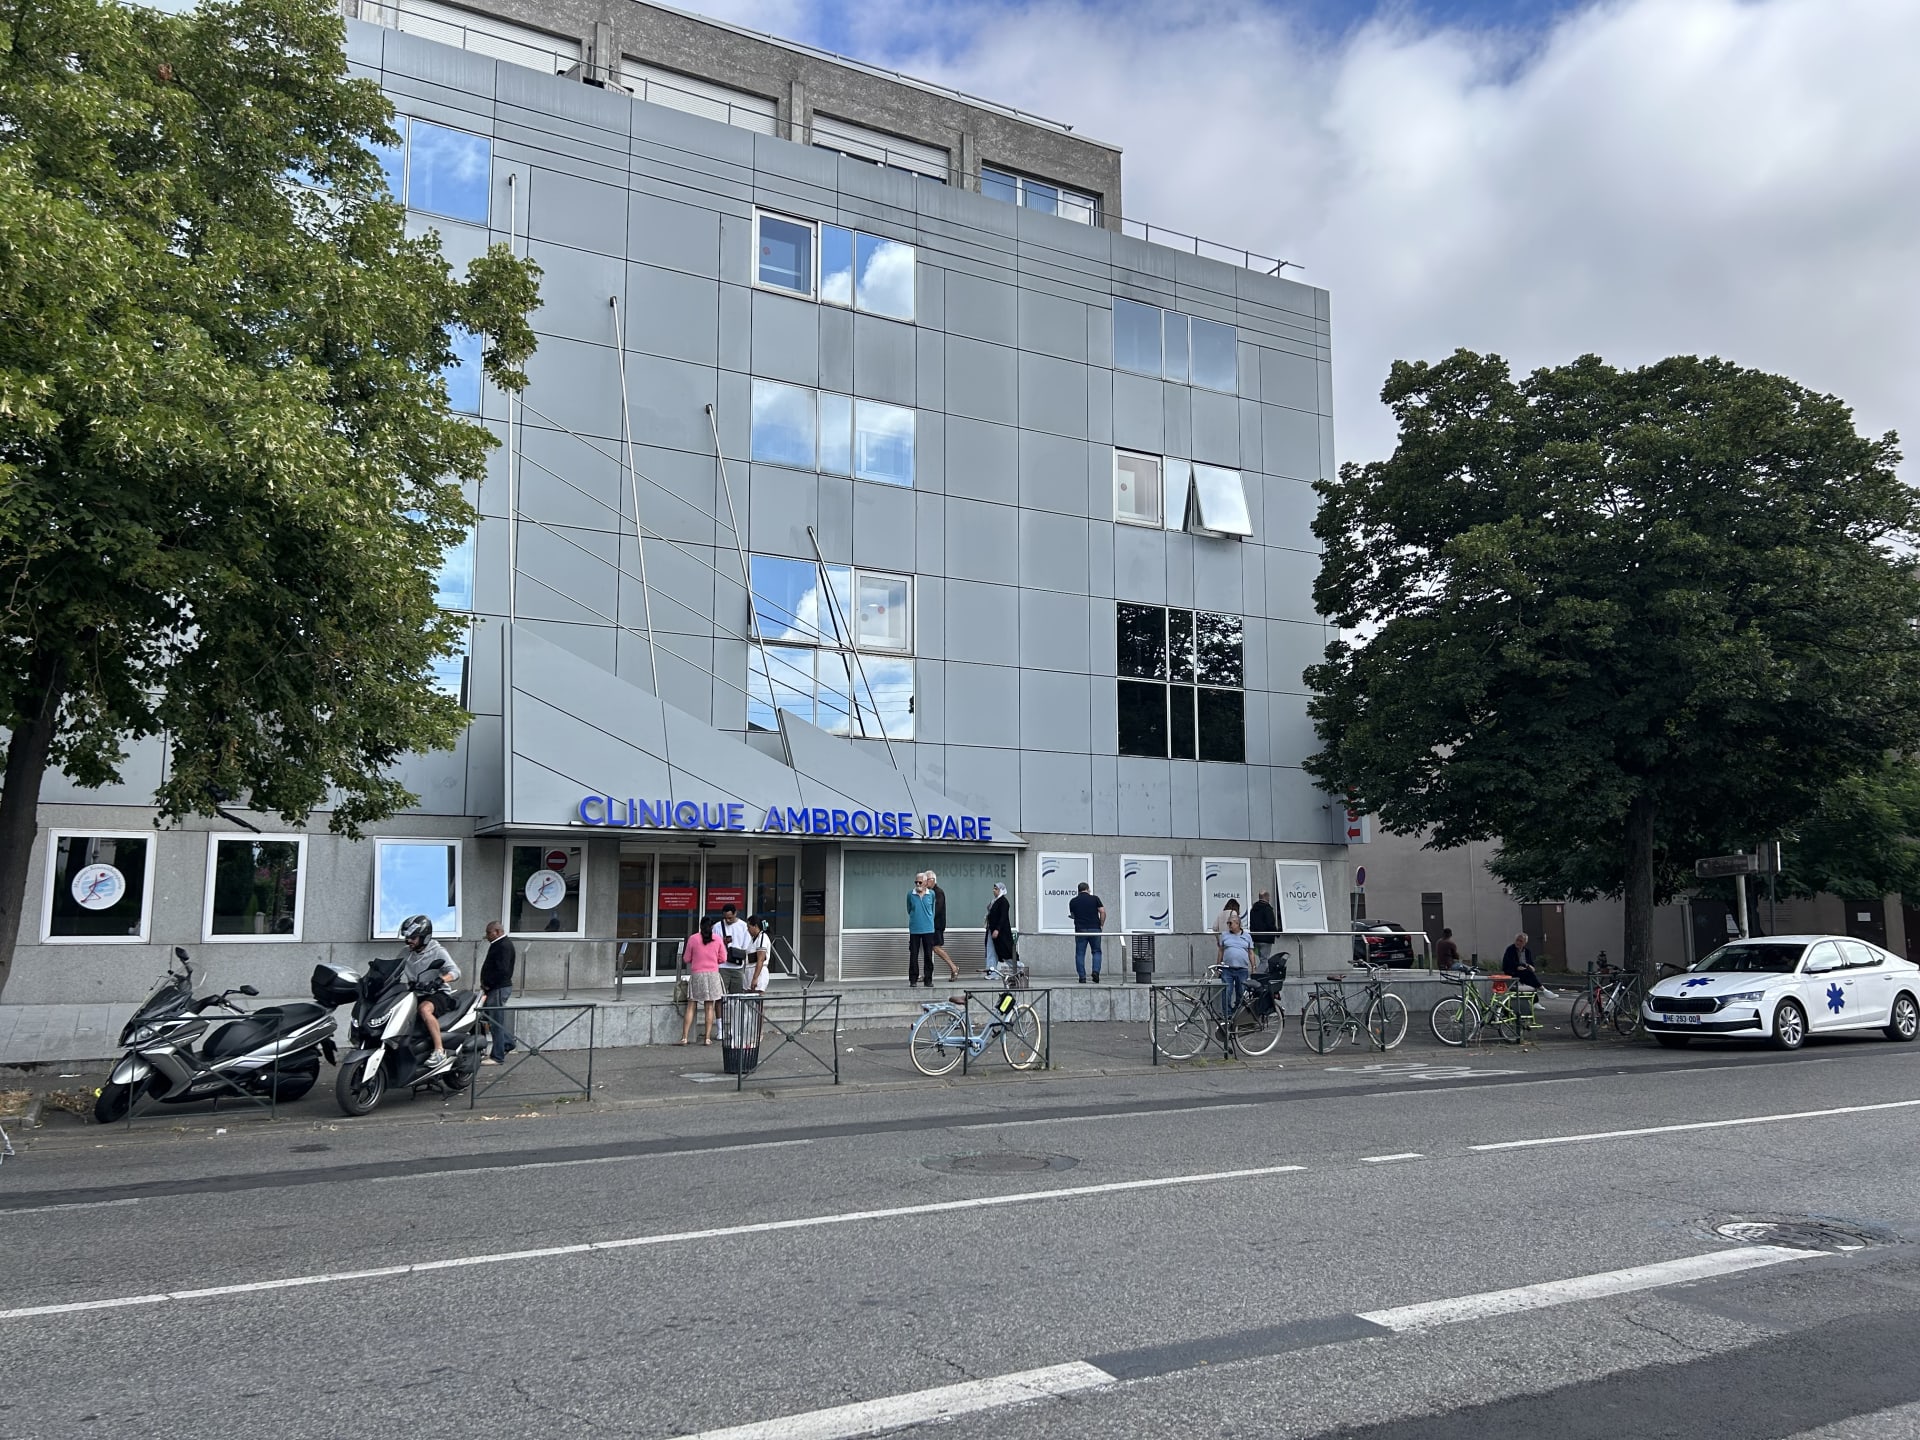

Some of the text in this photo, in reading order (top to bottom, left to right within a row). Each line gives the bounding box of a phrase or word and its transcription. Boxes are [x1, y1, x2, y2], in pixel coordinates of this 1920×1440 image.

[579, 795, 993, 840] CLINIQUE AMBROISE PARE
[980, 863, 1007, 878] PARE
